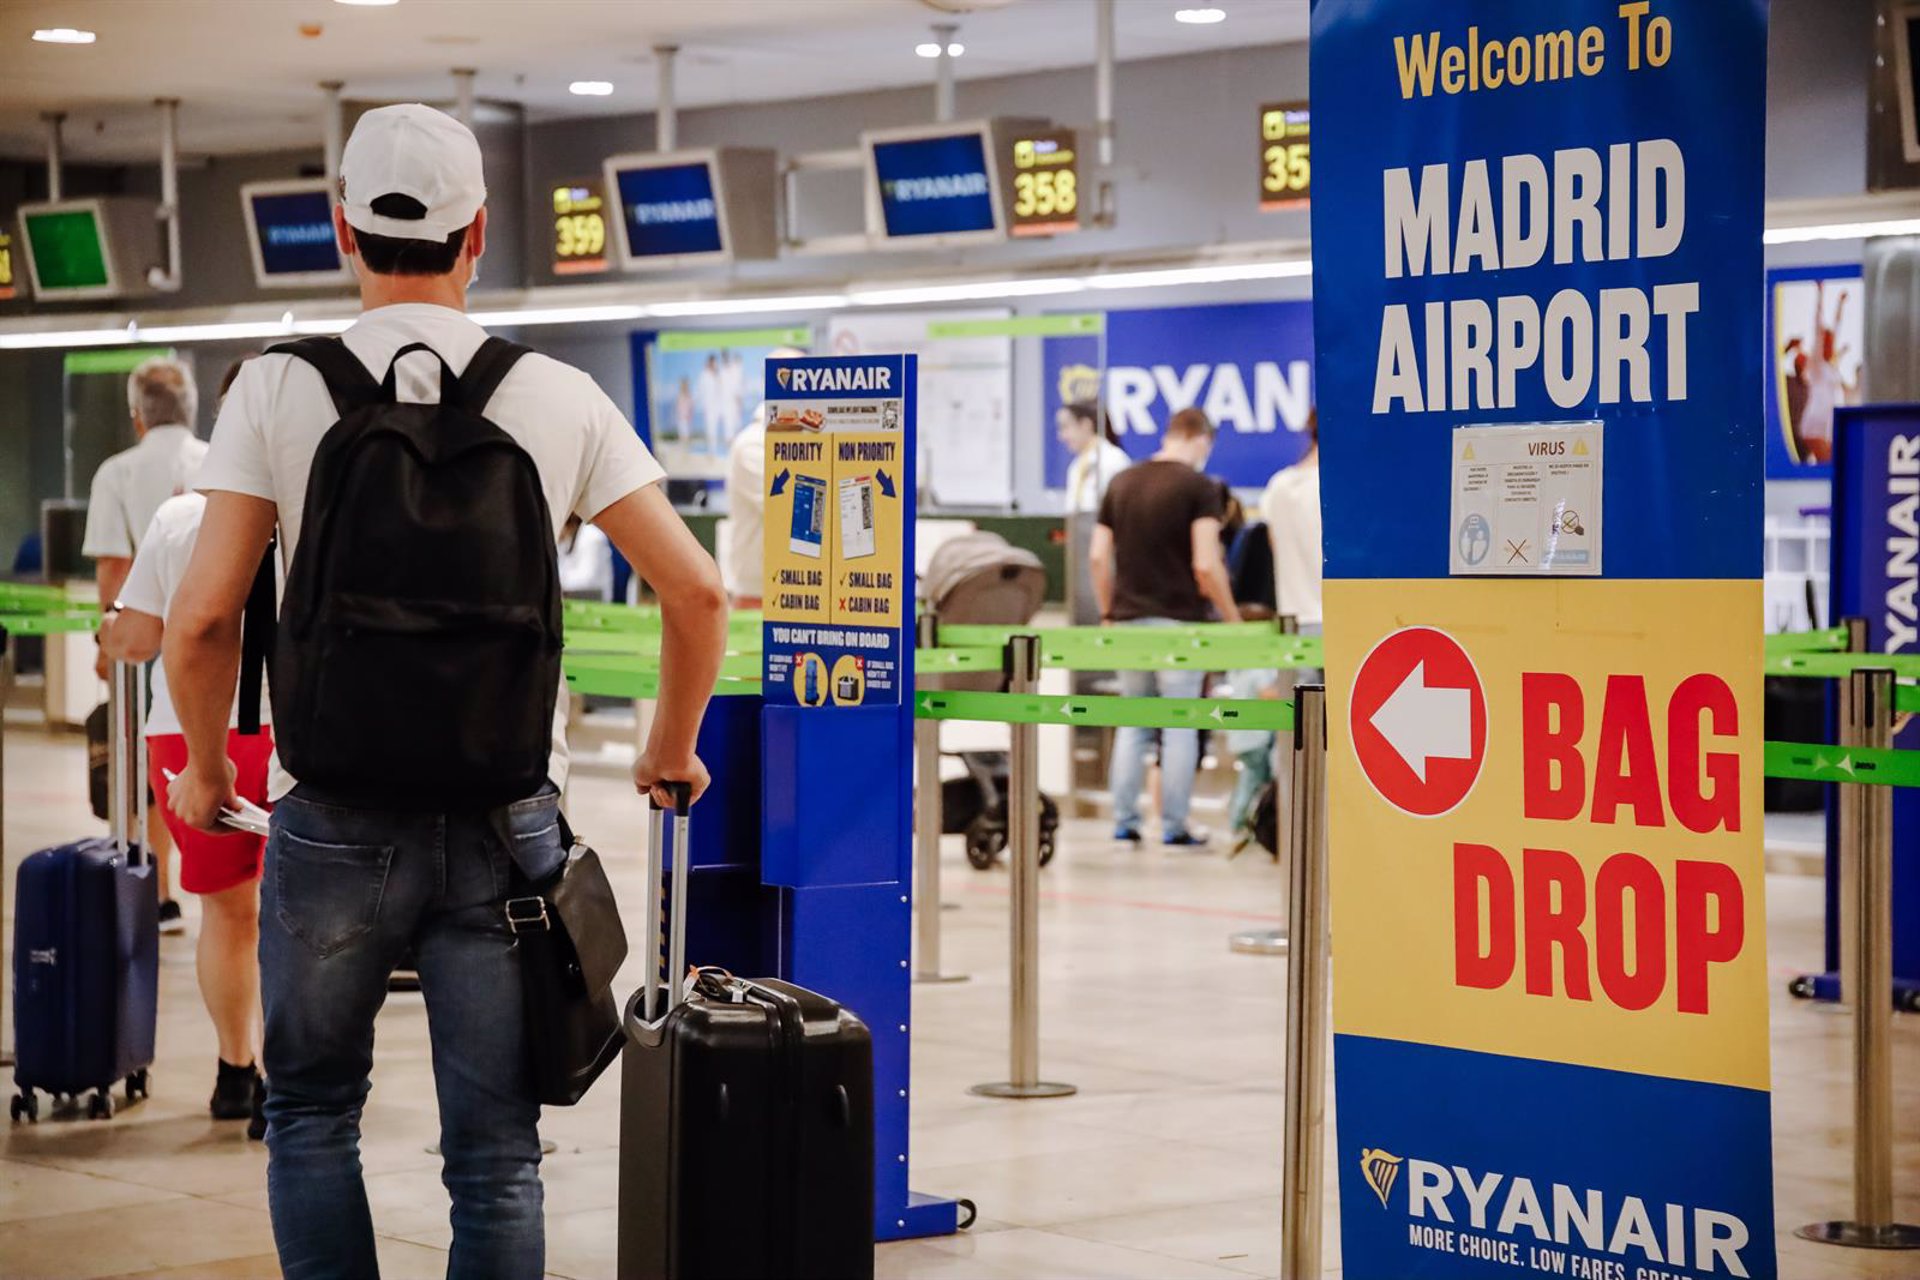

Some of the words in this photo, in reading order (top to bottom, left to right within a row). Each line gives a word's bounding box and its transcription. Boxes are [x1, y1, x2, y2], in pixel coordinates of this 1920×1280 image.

[1393, 25, 1605, 99] Welcome
[1618, 1, 1673, 71] To
[1014, 169, 1076, 216] 358
[1383, 138, 1686, 279] MADRID
[555, 214, 604, 256] 359
[1372, 282, 1700, 414] AIRPORT
[792, 367, 892, 391] RYANAIR
[774, 442, 823, 461] PRIORITY
[838, 442, 855, 461] NON
[857, 442, 896, 461] PRIORITY
[1528, 441, 1566, 456] VIRUS
[780, 569, 805, 585] SMALL
[807, 571, 822, 586] BAG
[1884, 433, 1920, 685] YANAIR
[849, 572, 875, 588] SMALL
[877, 573, 892, 589] BAG
[780, 594, 803, 609] CABIN
[804, 595, 820, 610] BAG
[848, 597, 873, 613] CABIN
[874, 598, 890, 614] BAG
[772, 627, 790, 643] YOU
[859, 632, 890, 649] BOARD
[1522, 672, 1741, 834] BAG
[1453, 842, 1745, 1015] DROP
[1408, 1158, 1751, 1279] RYANAIR
[1409, 1224, 1455, 1252] MORE
[1459, 1233, 1525, 1266] CHOICE.
[1530, 1247, 1564, 1274] LOW
